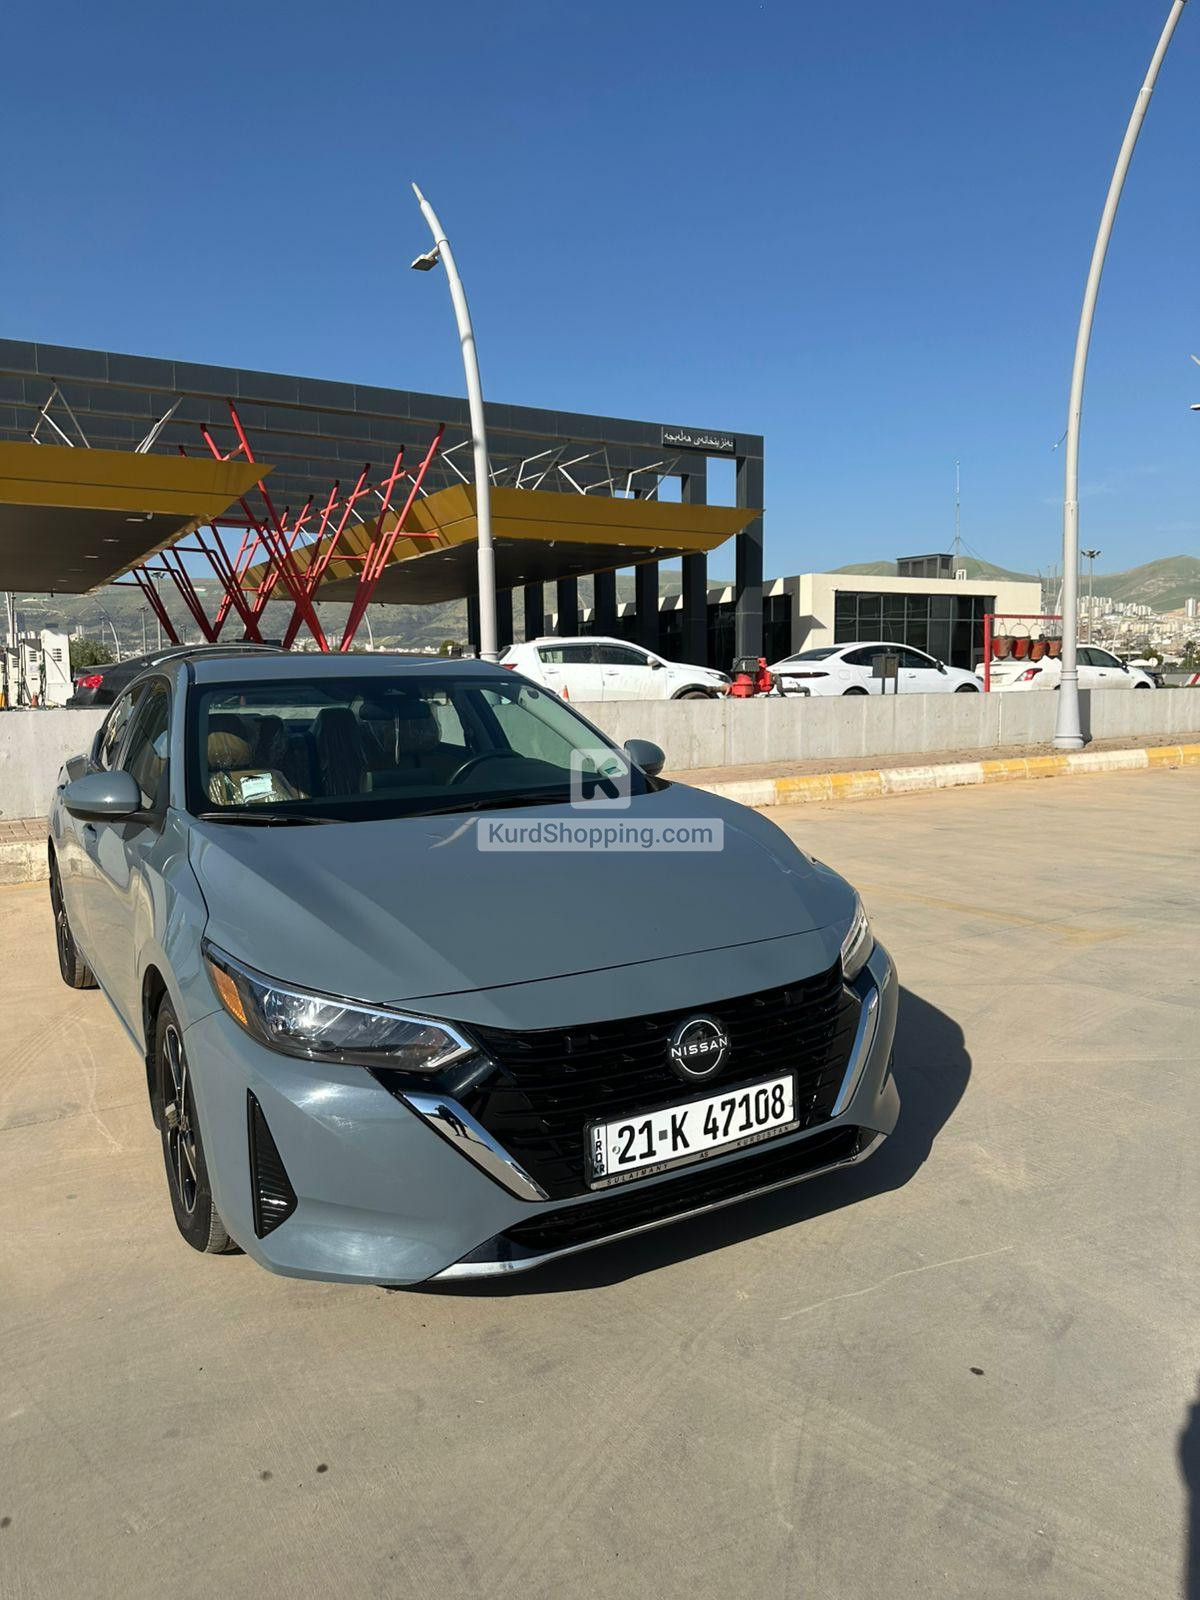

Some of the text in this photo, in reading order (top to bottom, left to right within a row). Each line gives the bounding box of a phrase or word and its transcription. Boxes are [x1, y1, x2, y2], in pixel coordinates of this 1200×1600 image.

[670, 1036, 728, 1058] NISSAN
[702, 1083, 785, 1140] 47108
[606, 1163, 669, 1186] SULAIMANY
